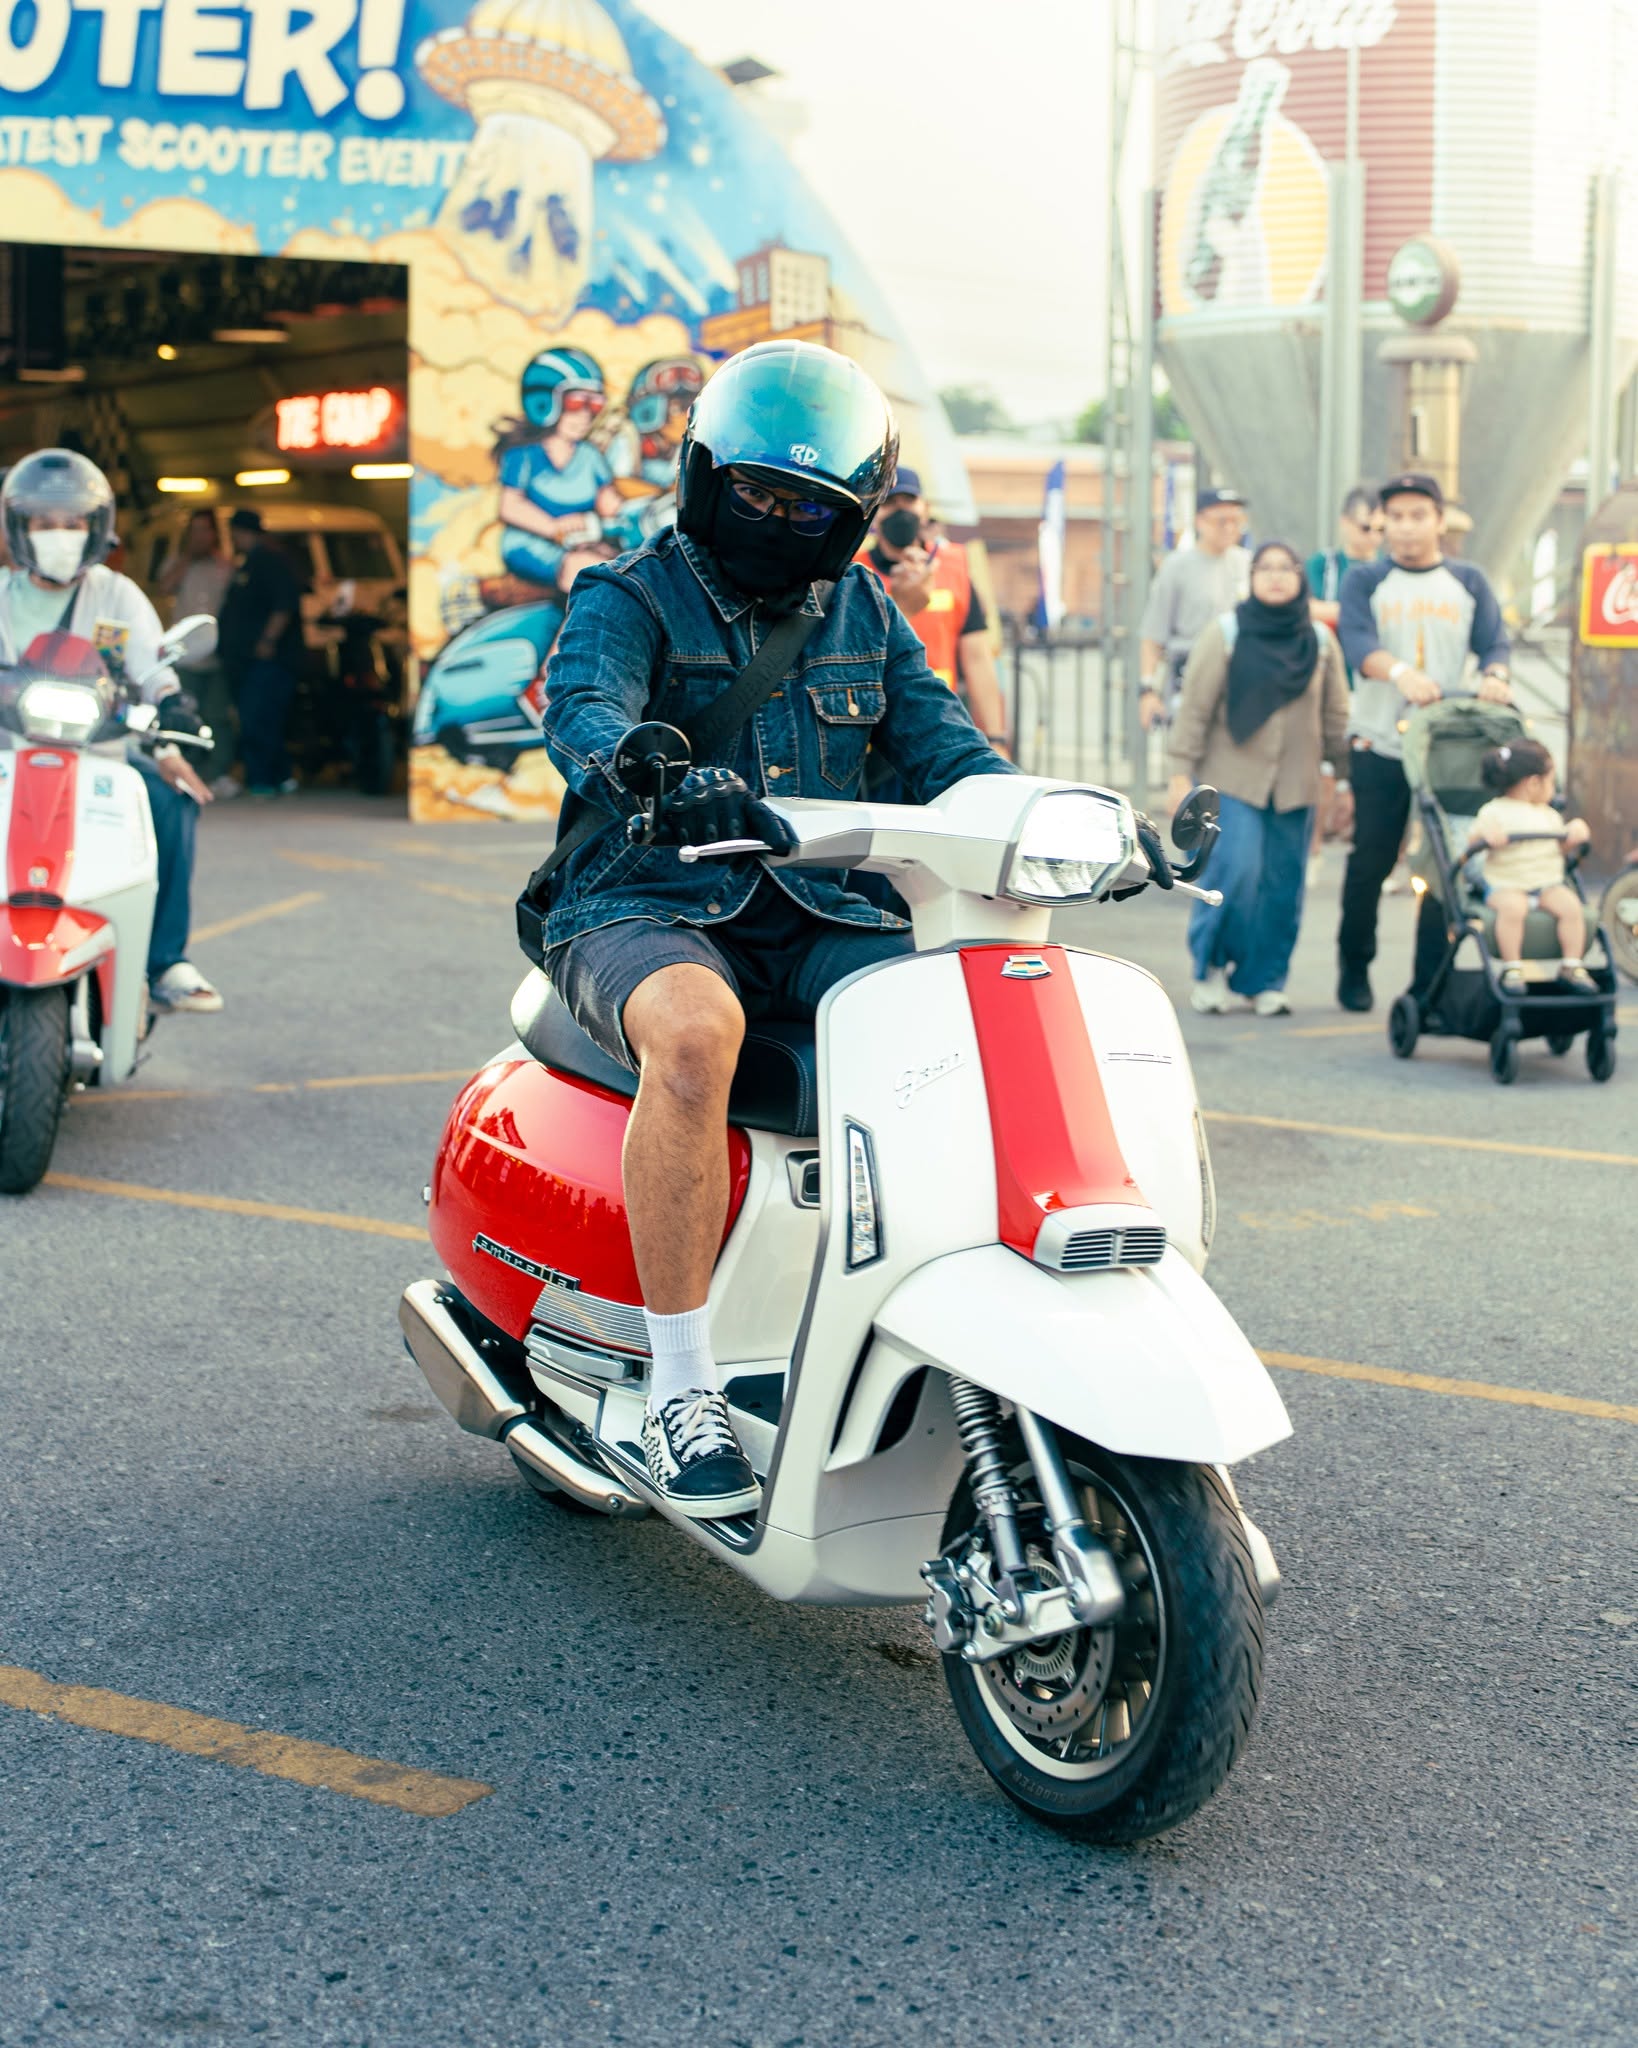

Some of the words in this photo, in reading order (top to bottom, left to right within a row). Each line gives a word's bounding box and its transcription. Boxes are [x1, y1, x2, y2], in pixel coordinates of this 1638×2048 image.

[0, 116, 113, 167] TEST
[119, 119, 333, 182] SCOOTER
[340, 138, 468, 188] EVENT
